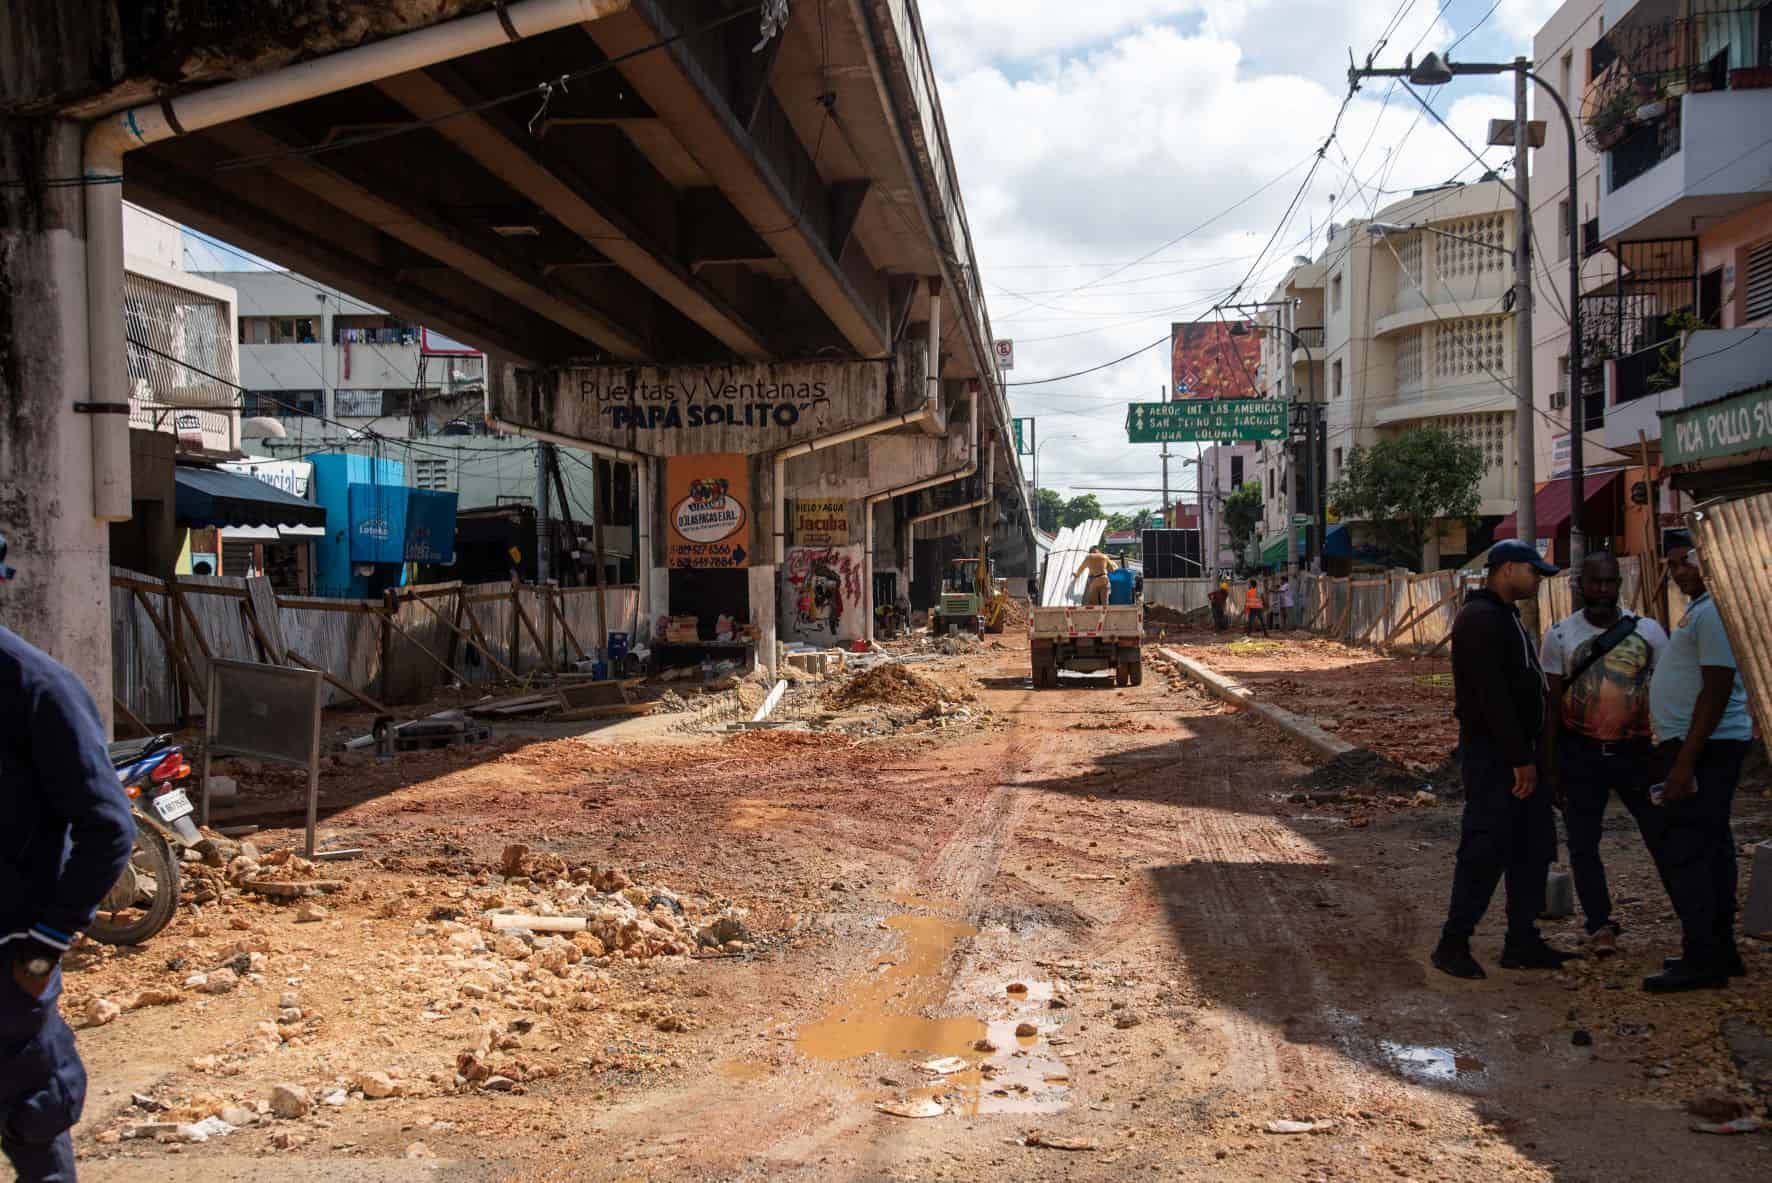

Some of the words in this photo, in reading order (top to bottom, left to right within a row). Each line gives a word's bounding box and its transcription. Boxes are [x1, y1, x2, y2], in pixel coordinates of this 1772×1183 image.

[581, 380, 675, 401] Puertas
[703, 378, 827, 400] Ventanas
[1210, 404, 1229, 415] LAS
[1235, 402, 1283, 414] AMERICAS
[1675, 418, 1705, 454] PICA
[1707, 407, 1752, 449] POLLO
[823, 503, 844, 513] AGUA
[797, 513, 848, 532] Jacuba
